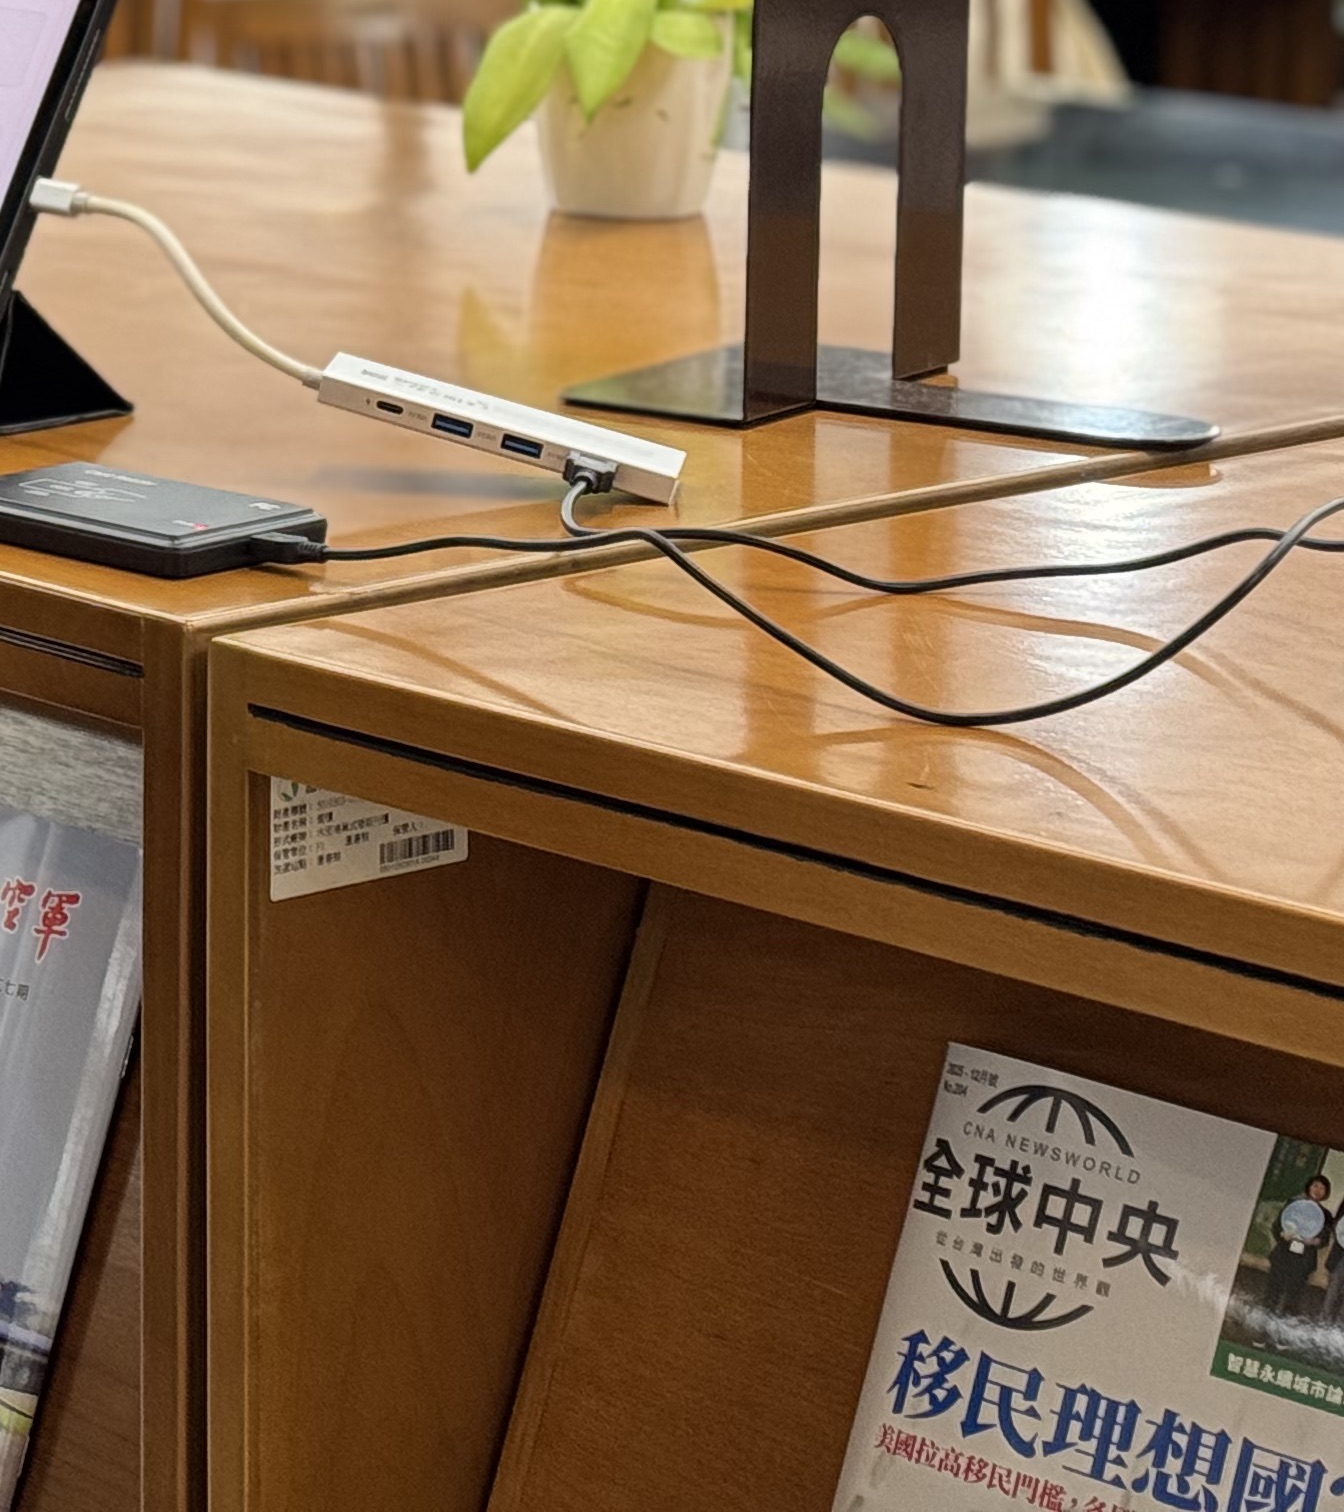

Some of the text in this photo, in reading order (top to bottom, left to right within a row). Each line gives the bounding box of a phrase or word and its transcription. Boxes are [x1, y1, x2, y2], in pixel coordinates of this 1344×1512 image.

[913, 1138, 1179, 1287] 全球中央
[963, 1120, 1141, 1185] CNA NEWSWORLD
[885, 1329, 1329, 1512] 移民理想國
